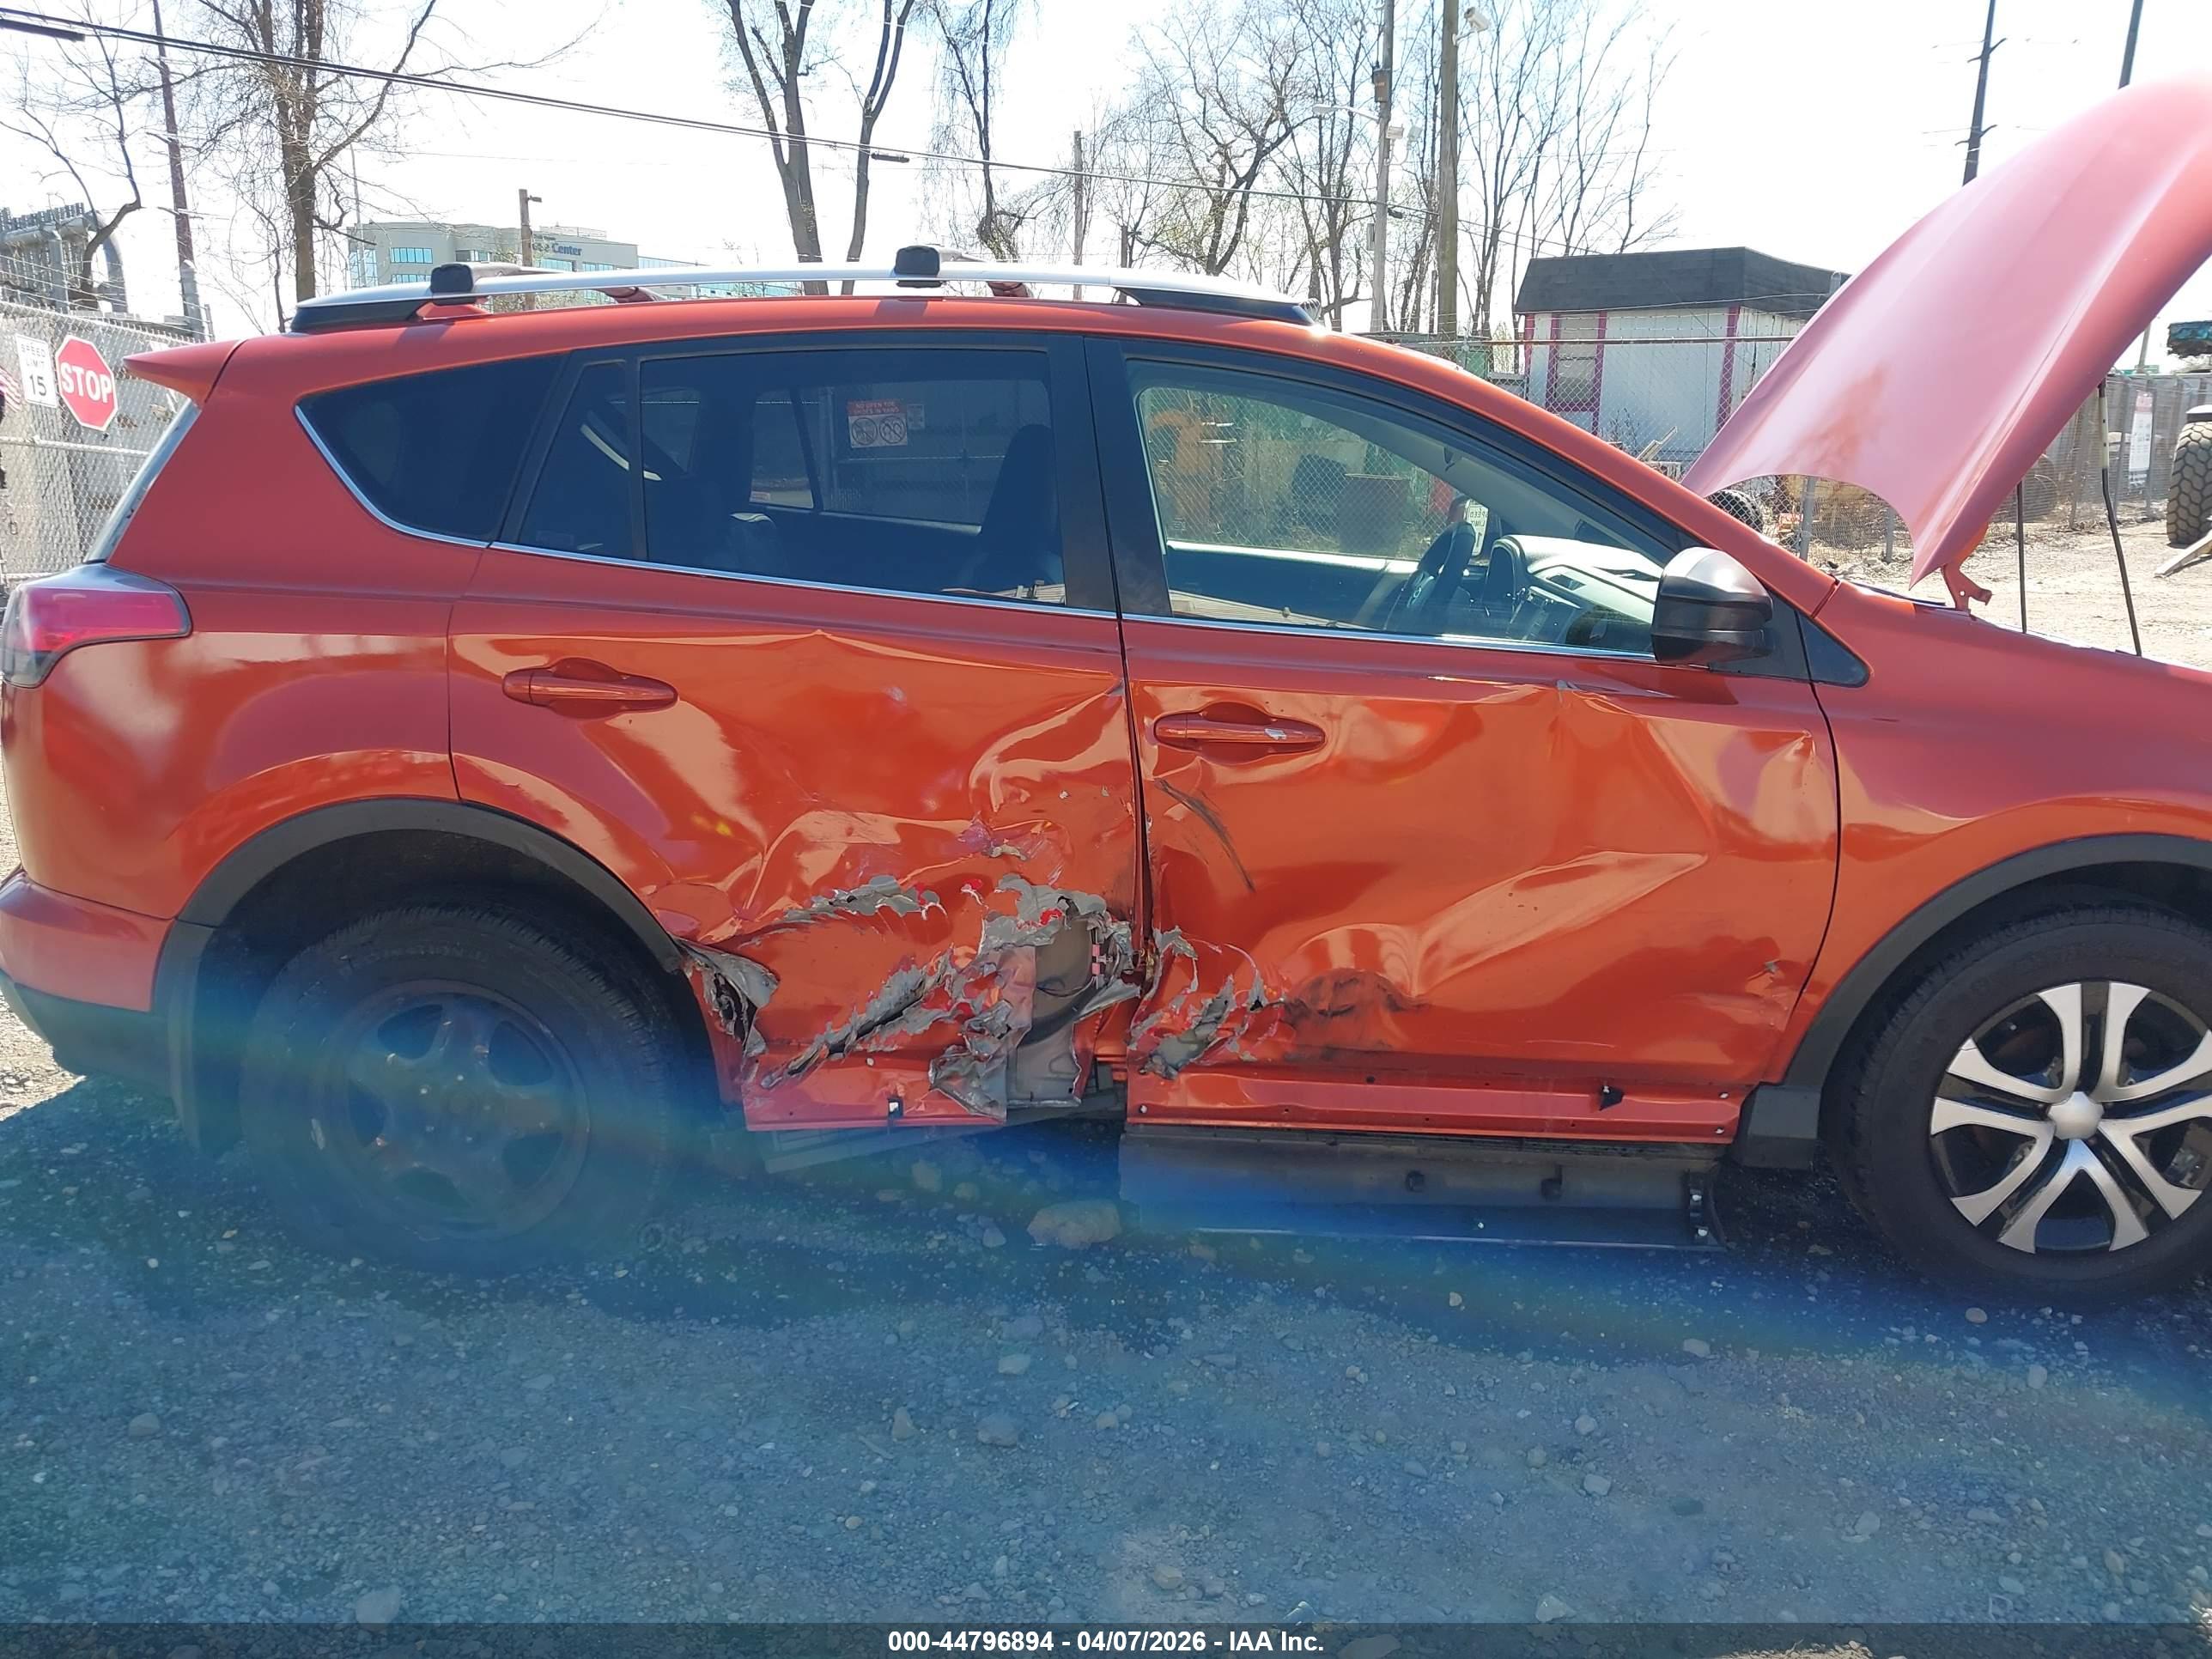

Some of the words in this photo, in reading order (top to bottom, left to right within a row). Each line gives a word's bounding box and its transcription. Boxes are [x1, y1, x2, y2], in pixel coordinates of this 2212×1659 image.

[551, 242, 582, 256] Center
[21, 343, 46, 357] SPEED
[29, 374, 47, 397] 15
[60, 362, 112, 404] STOP
